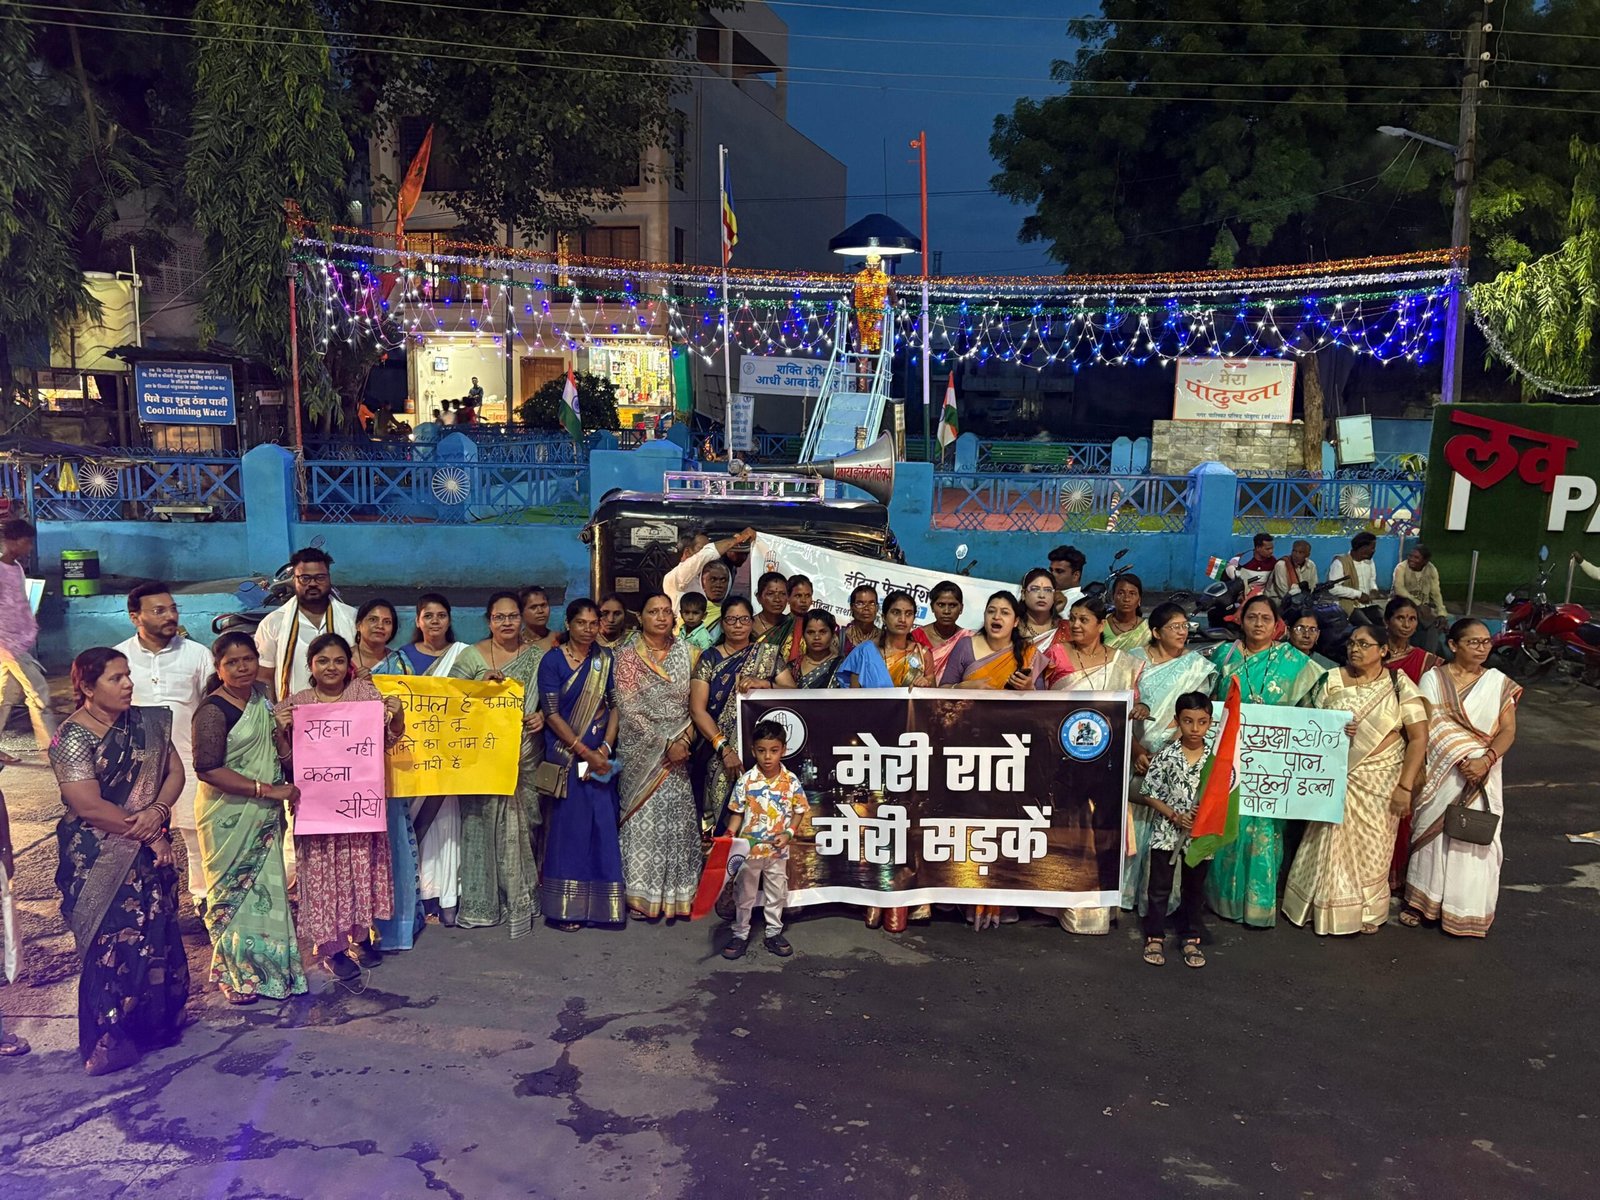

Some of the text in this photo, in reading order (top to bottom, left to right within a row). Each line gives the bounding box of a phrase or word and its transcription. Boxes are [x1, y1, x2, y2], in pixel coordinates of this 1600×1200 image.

[777, 363, 802, 375] शक्ति
[1219, 368, 1248, 386] मेरा
[755, 374, 781, 386] आधी
[146, 405, 227, 418] Cool Drinking Water
[161, 396, 173, 404] का
[192, 396, 207, 406] ठंडा
[208, 397, 229, 407] पानी
[1444, 410, 1579, 493] लव
[1446, 472, 1471, 531] I
[460, 691, 473, 713] है
[304, 719, 352, 740] सहना
[412, 715, 444, 732] नही
[423, 739, 440, 750] का
[448, 737, 478, 749] नाम
[483, 732, 499, 749] ही
[1245, 724, 1291, 749] सुरक्षा
[1293, 720, 1341, 748] खोल
[346, 737, 376, 757] नही
[414, 755, 462, 771] नारी है
[833, 732, 1032, 793] मेरी रातें
[303, 767, 352, 781] कहना
[1240, 765, 1292, 796] सहेली
[336, 789, 382, 818] सीखो
[812, 804, 1052, 876] मेरी सड़कें
